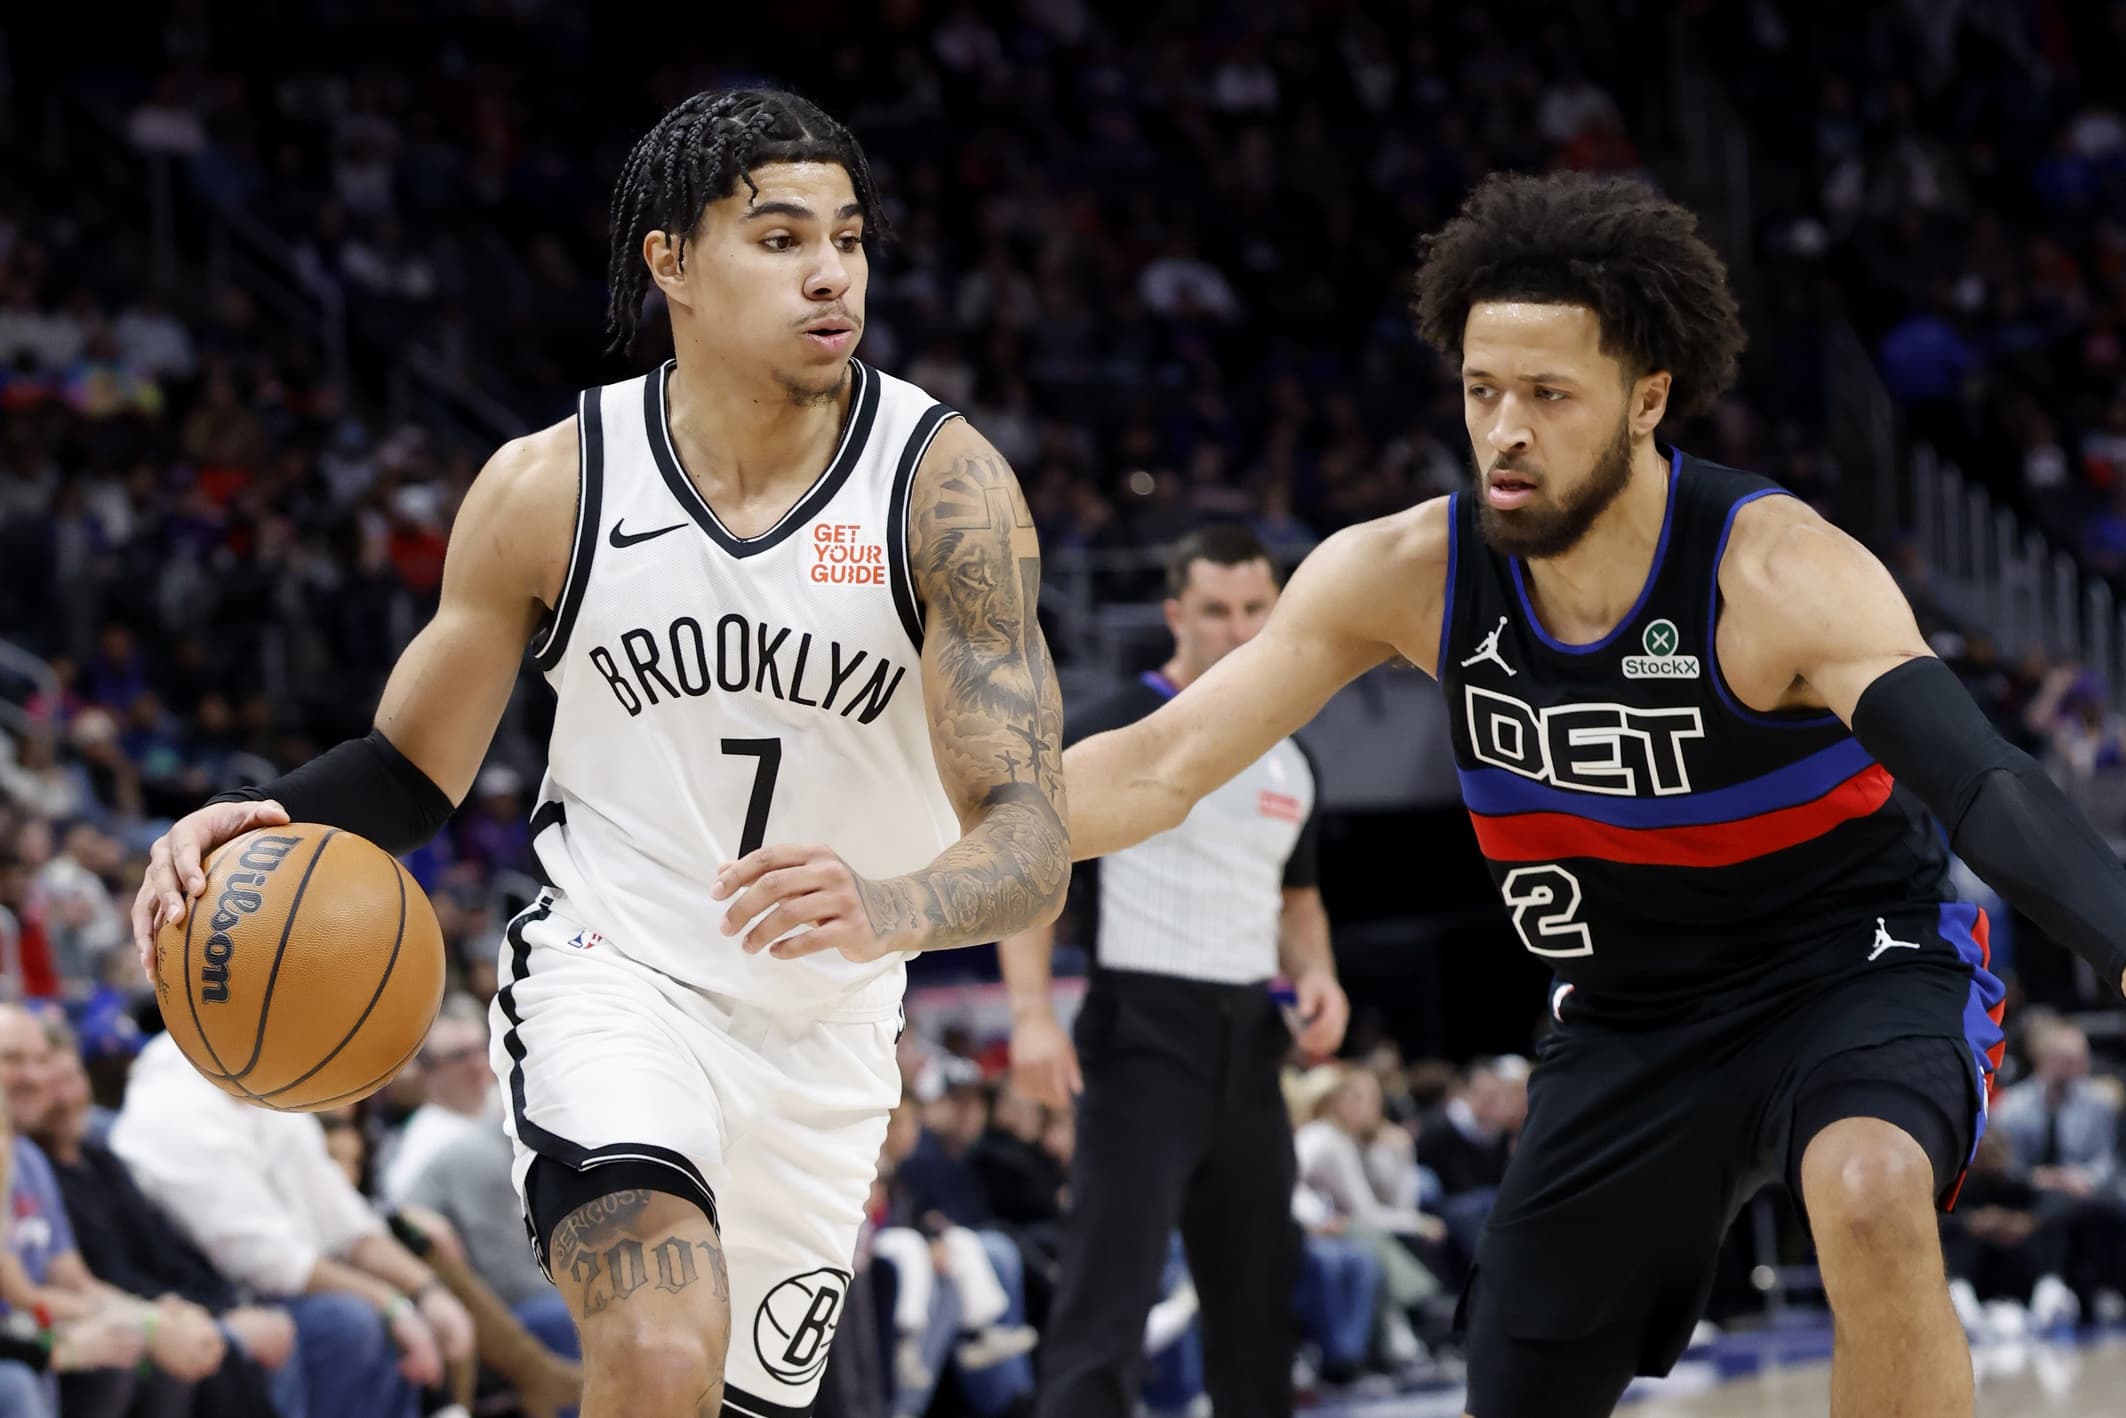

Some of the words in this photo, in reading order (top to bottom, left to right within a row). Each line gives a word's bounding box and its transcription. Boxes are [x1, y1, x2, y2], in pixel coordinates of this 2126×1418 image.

[810, 563, 886, 585] GUIDE
[814, 523, 861, 543] GET
[814, 543, 882, 564] YOUR
[588, 613, 906, 725] BROOKLYN
[1625, 658, 1698, 675] StockX
[1464, 684, 1705, 797] DET
[720, 737, 782, 861] 7
[200, 834, 305, 1005] Wilson
[1501, 864, 1594, 958] 2
[781, 1285, 840, 1368] B
